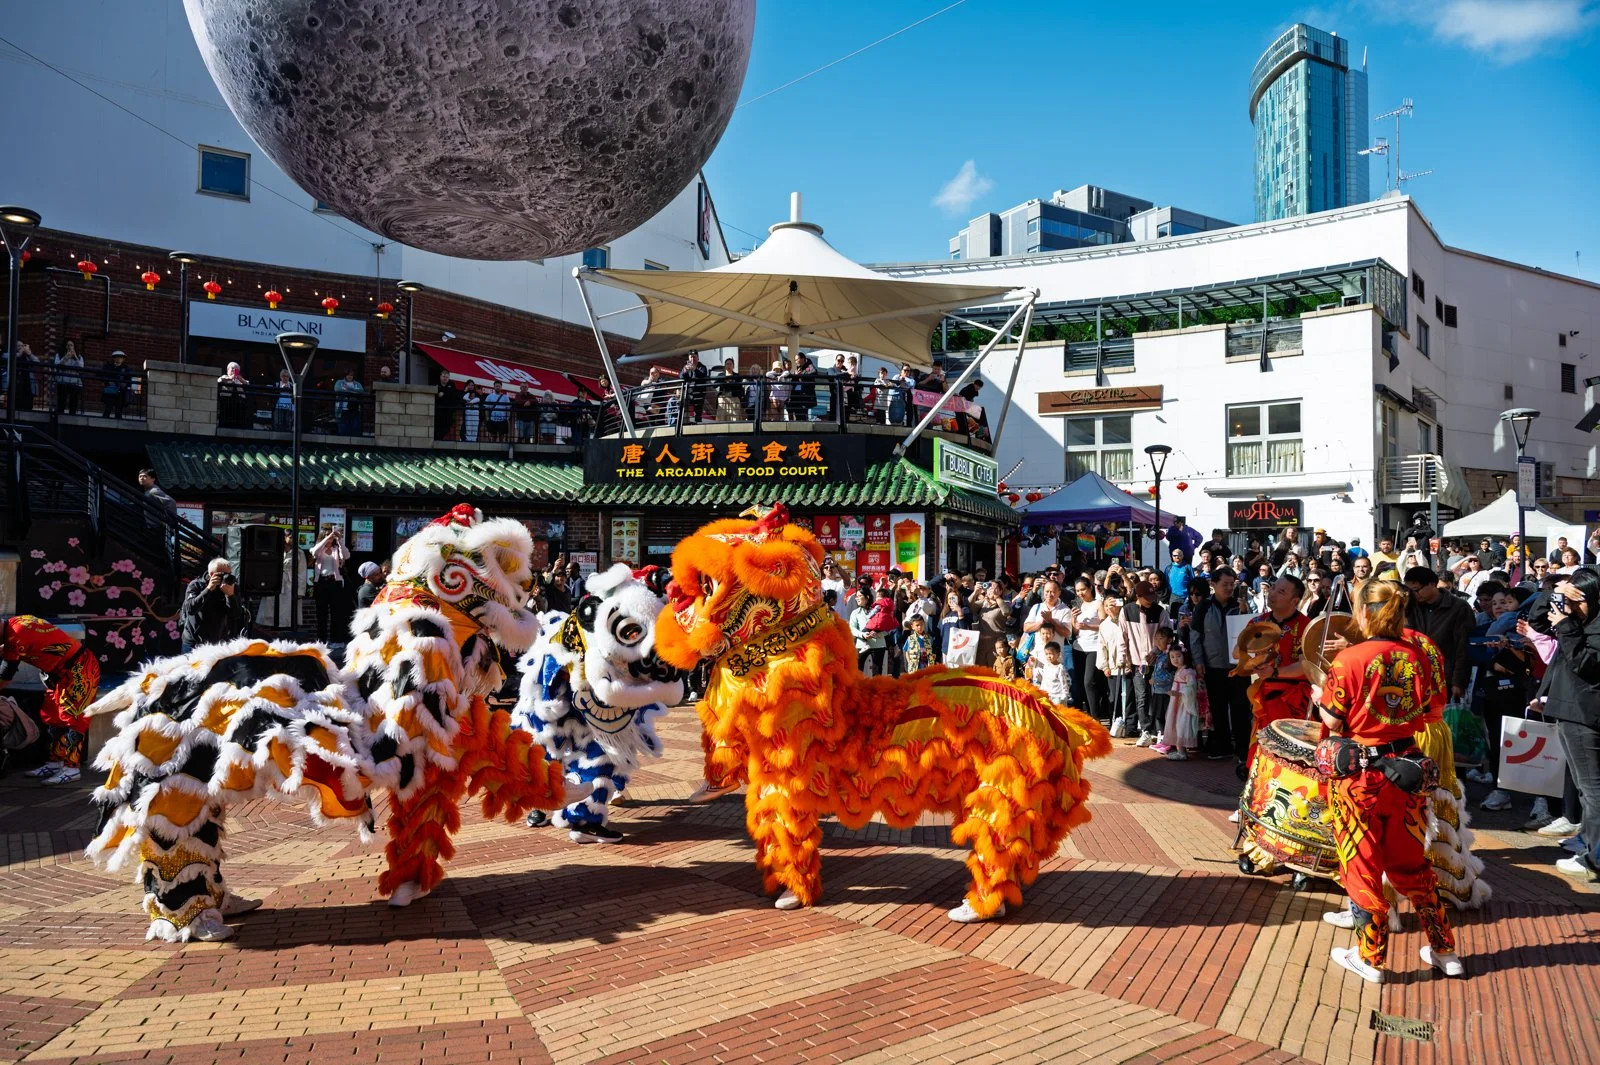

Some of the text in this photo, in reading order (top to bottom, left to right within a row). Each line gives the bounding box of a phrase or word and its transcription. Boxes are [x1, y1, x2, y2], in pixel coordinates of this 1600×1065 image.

[238, 314, 322, 336] BLANC NRI
[620, 440, 824, 464] 唐人街美食城
[616, 466, 829, 478] THE ARCADIAN FOOD COURT
